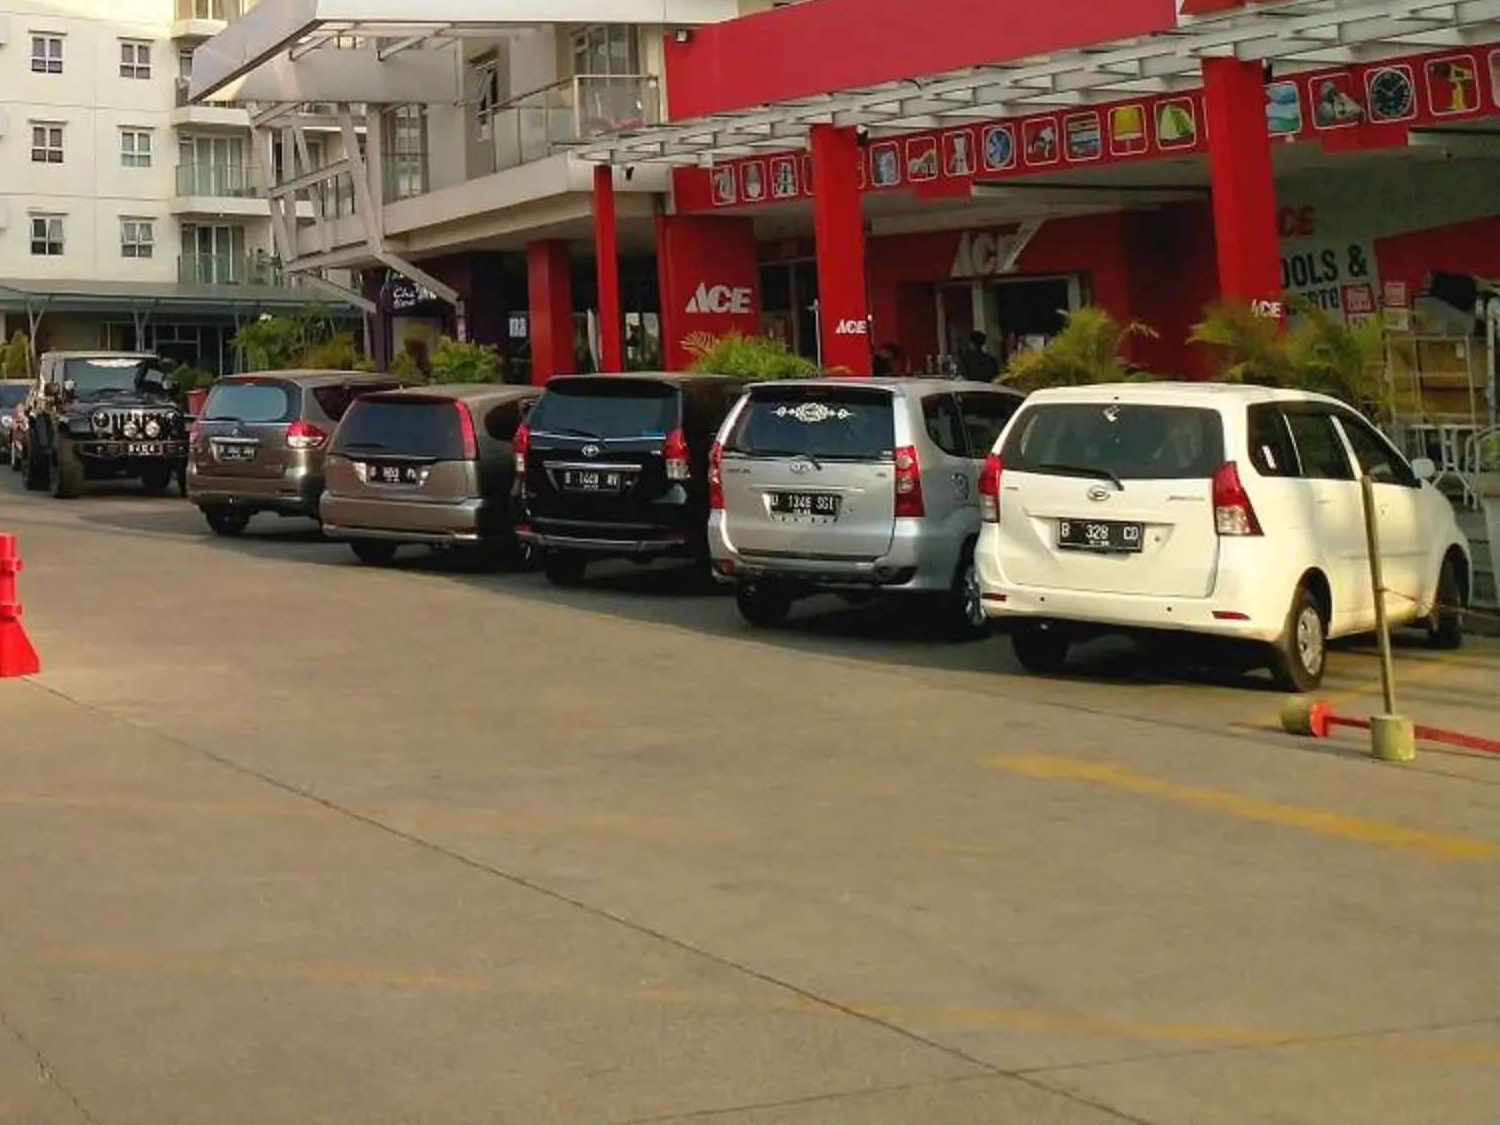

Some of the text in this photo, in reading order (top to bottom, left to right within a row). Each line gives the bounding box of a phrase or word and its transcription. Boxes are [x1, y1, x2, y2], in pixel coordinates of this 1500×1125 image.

[1277, 205, 1316, 238] CE
[1280, 248, 1338, 290] OOLS
[684, 282, 753, 315] ACE
[835, 319, 867, 335] ACE
[1085, 524, 1109, 540] 328
